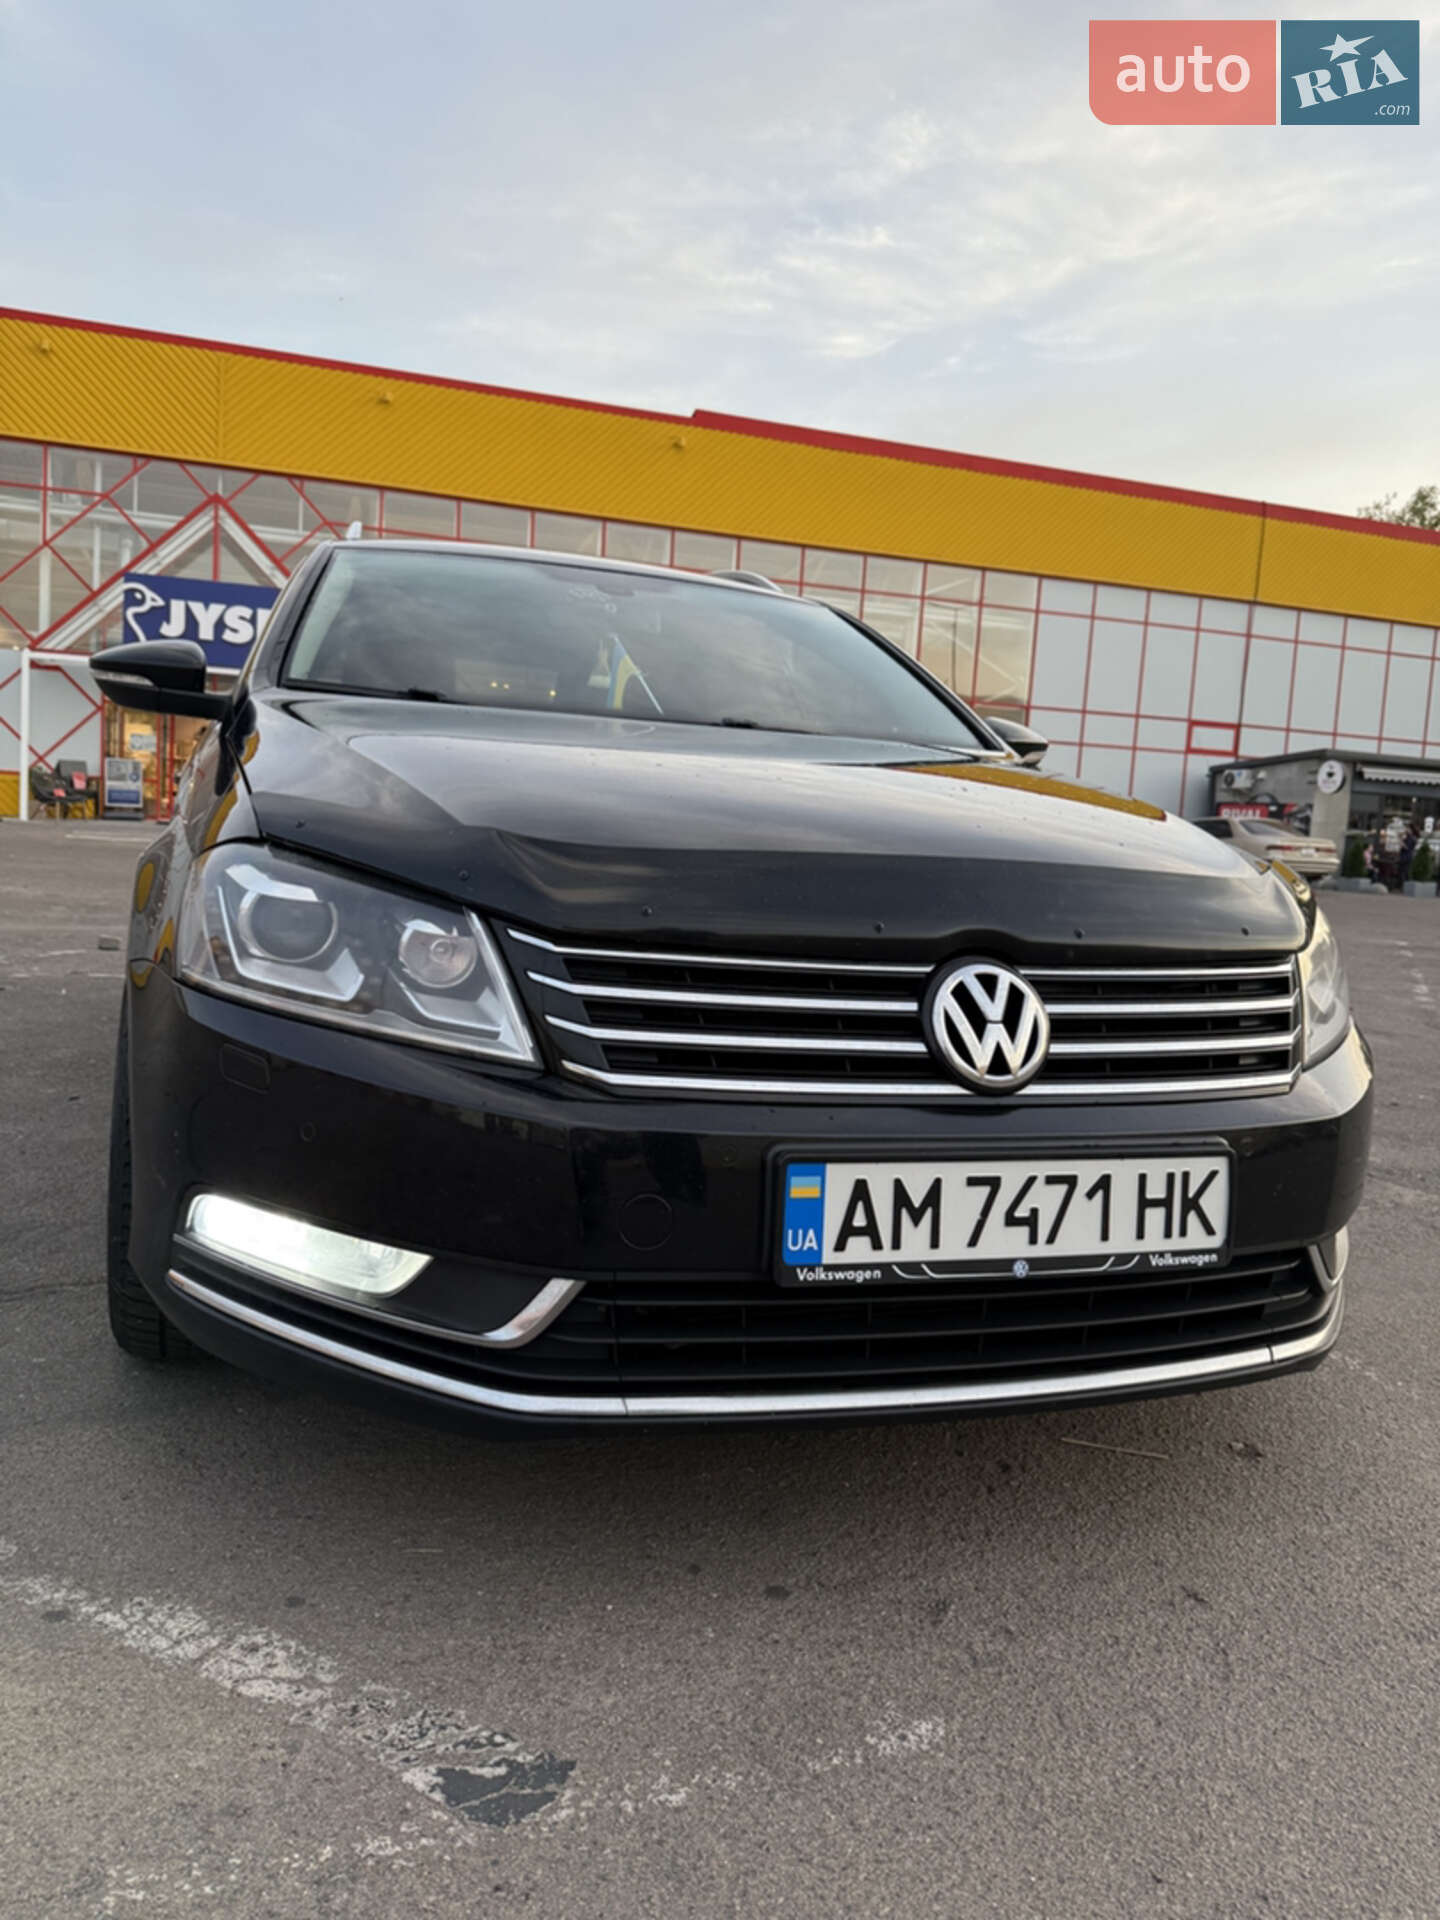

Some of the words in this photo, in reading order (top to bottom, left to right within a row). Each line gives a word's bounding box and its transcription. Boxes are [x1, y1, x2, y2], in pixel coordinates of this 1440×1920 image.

[833, 1176, 942, 1253] AM
[966, 1173, 1112, 1249] 7471
[1135, 1168, 1220, 1241] HK
[787, 1229, 819, 1252] UA
[1149, 1251, 1218, 1267] Volkswagen
[796, 1266, 882, 1283] Volkswagen
